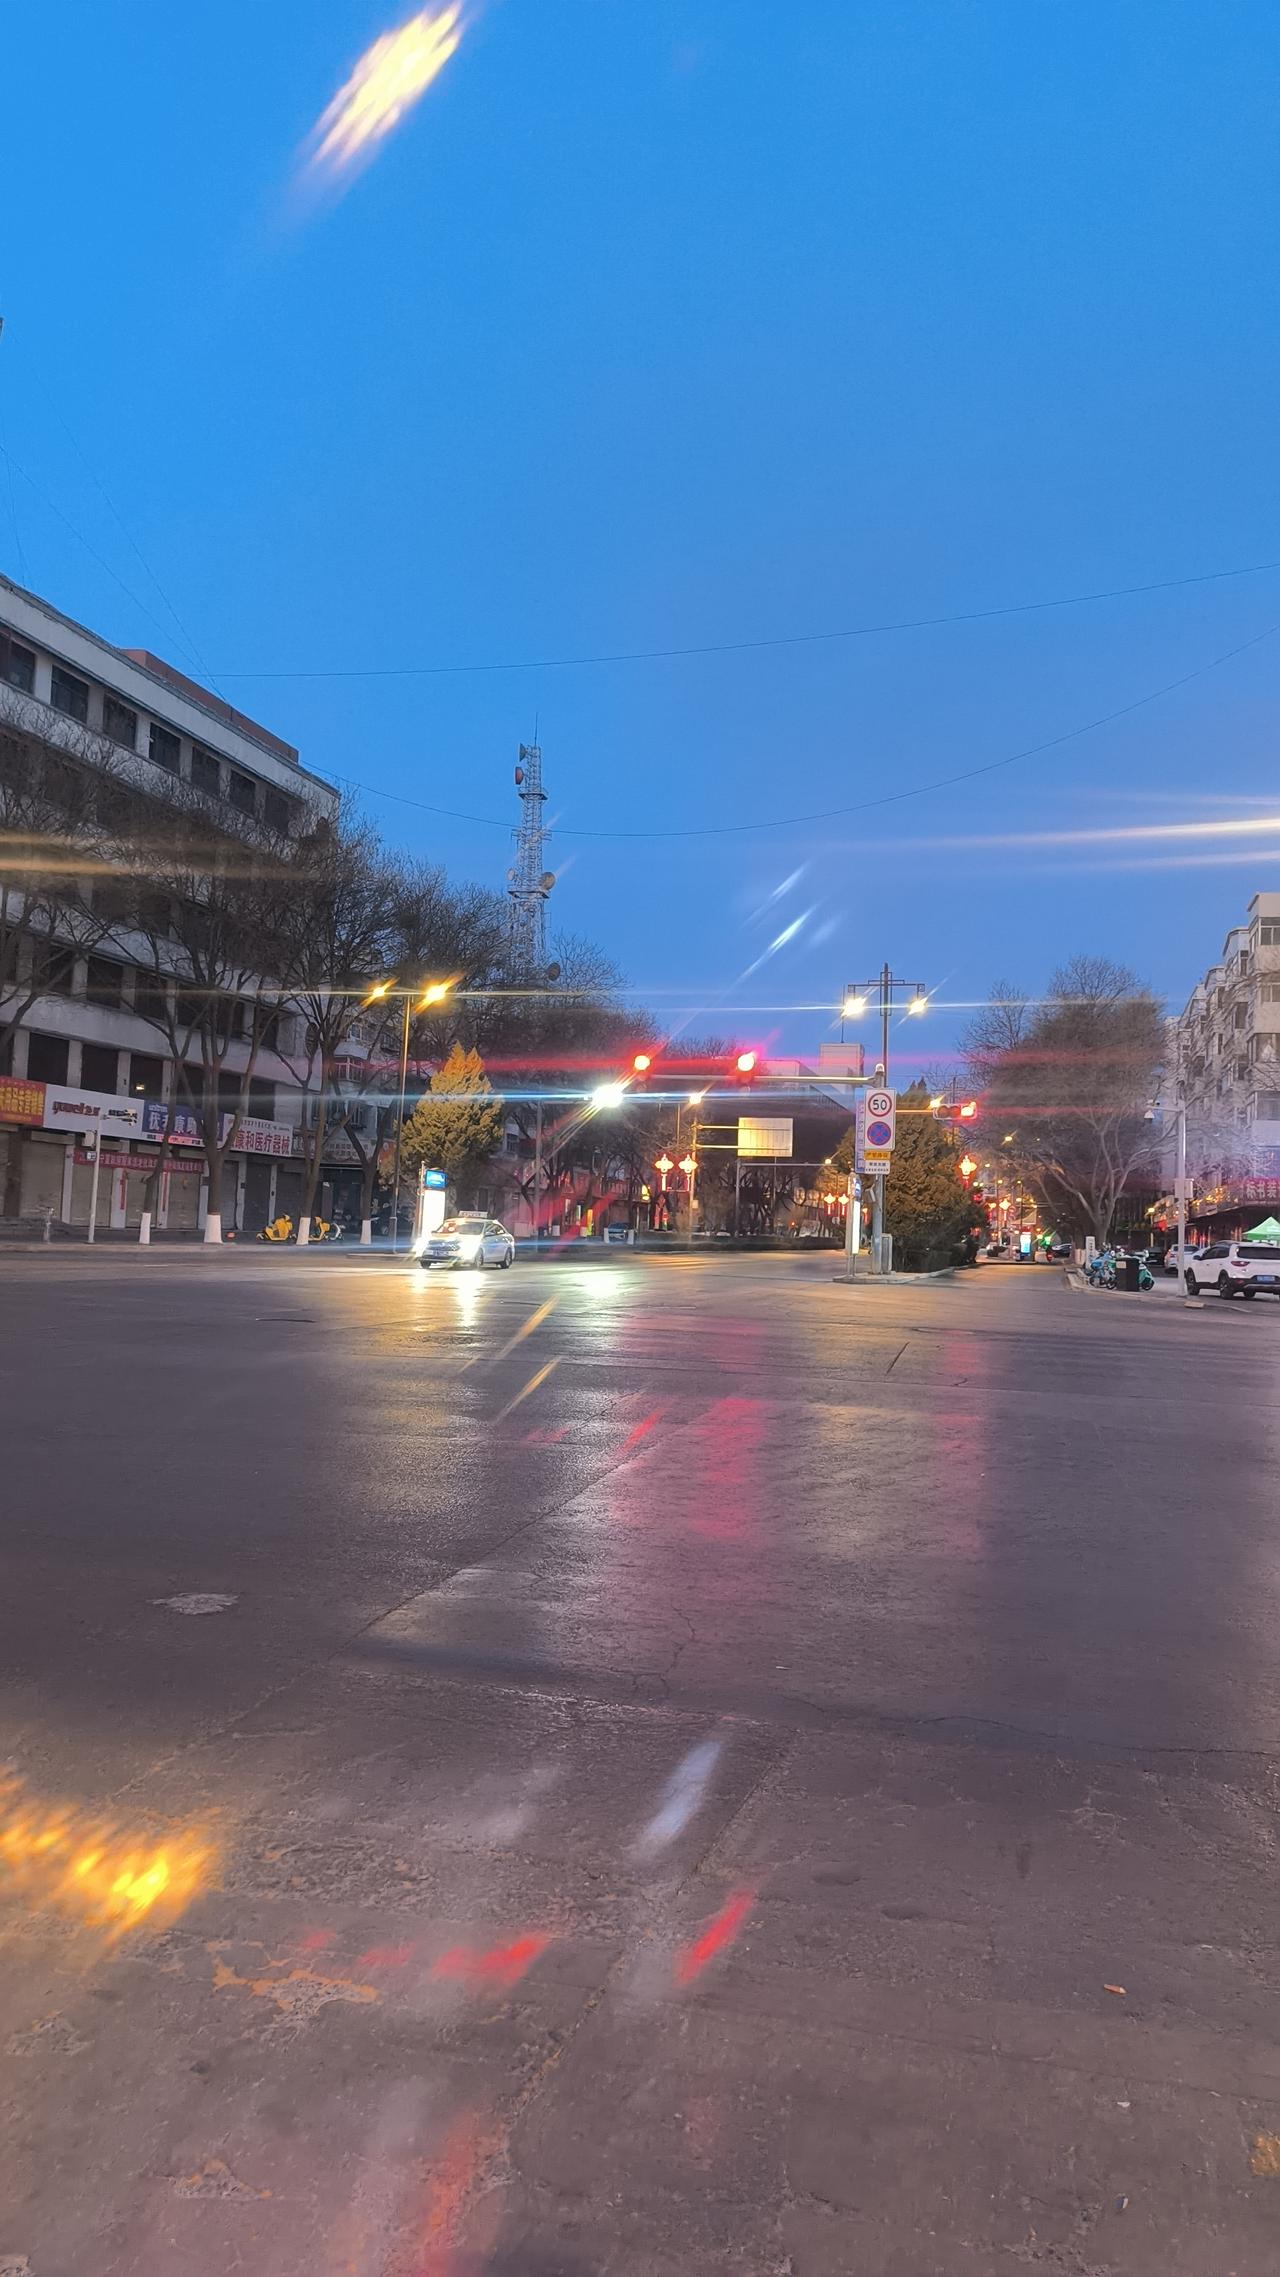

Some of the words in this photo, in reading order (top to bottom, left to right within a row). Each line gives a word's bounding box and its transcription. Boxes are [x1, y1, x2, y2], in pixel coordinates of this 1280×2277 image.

[873, 1099, 887, 1111] 50
[232, 1129, 290, 1154] 康和医疗器械
